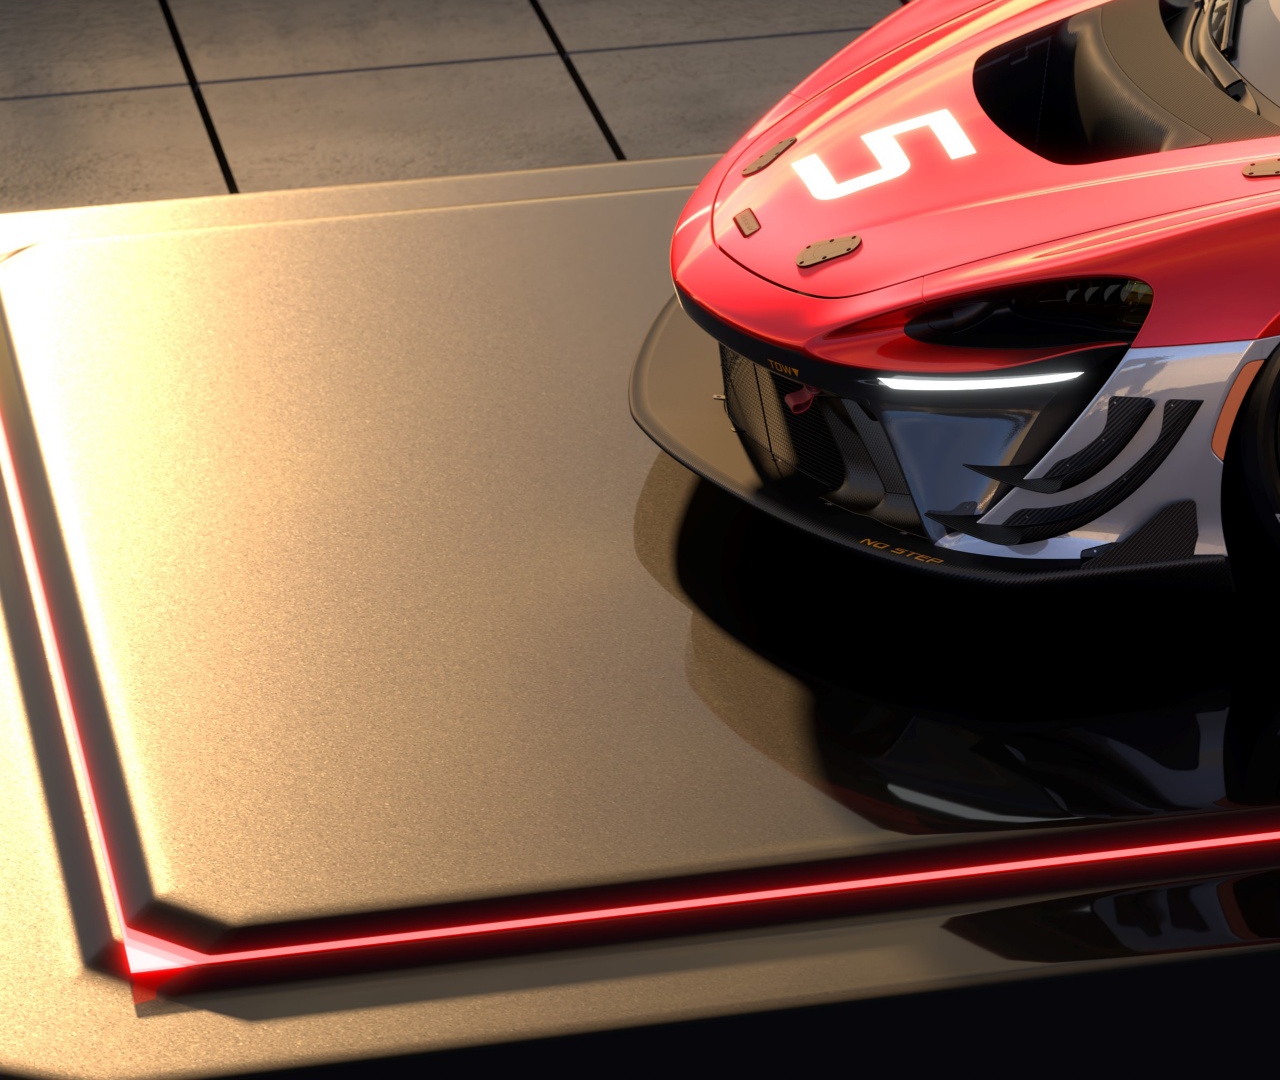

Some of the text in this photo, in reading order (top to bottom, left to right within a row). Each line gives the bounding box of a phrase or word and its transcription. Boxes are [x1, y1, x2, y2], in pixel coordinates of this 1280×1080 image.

[790, 108, 977, 201] 5
[767, 358, 792, 376] TOW
[860, 538, 945, 564] NO STEP
